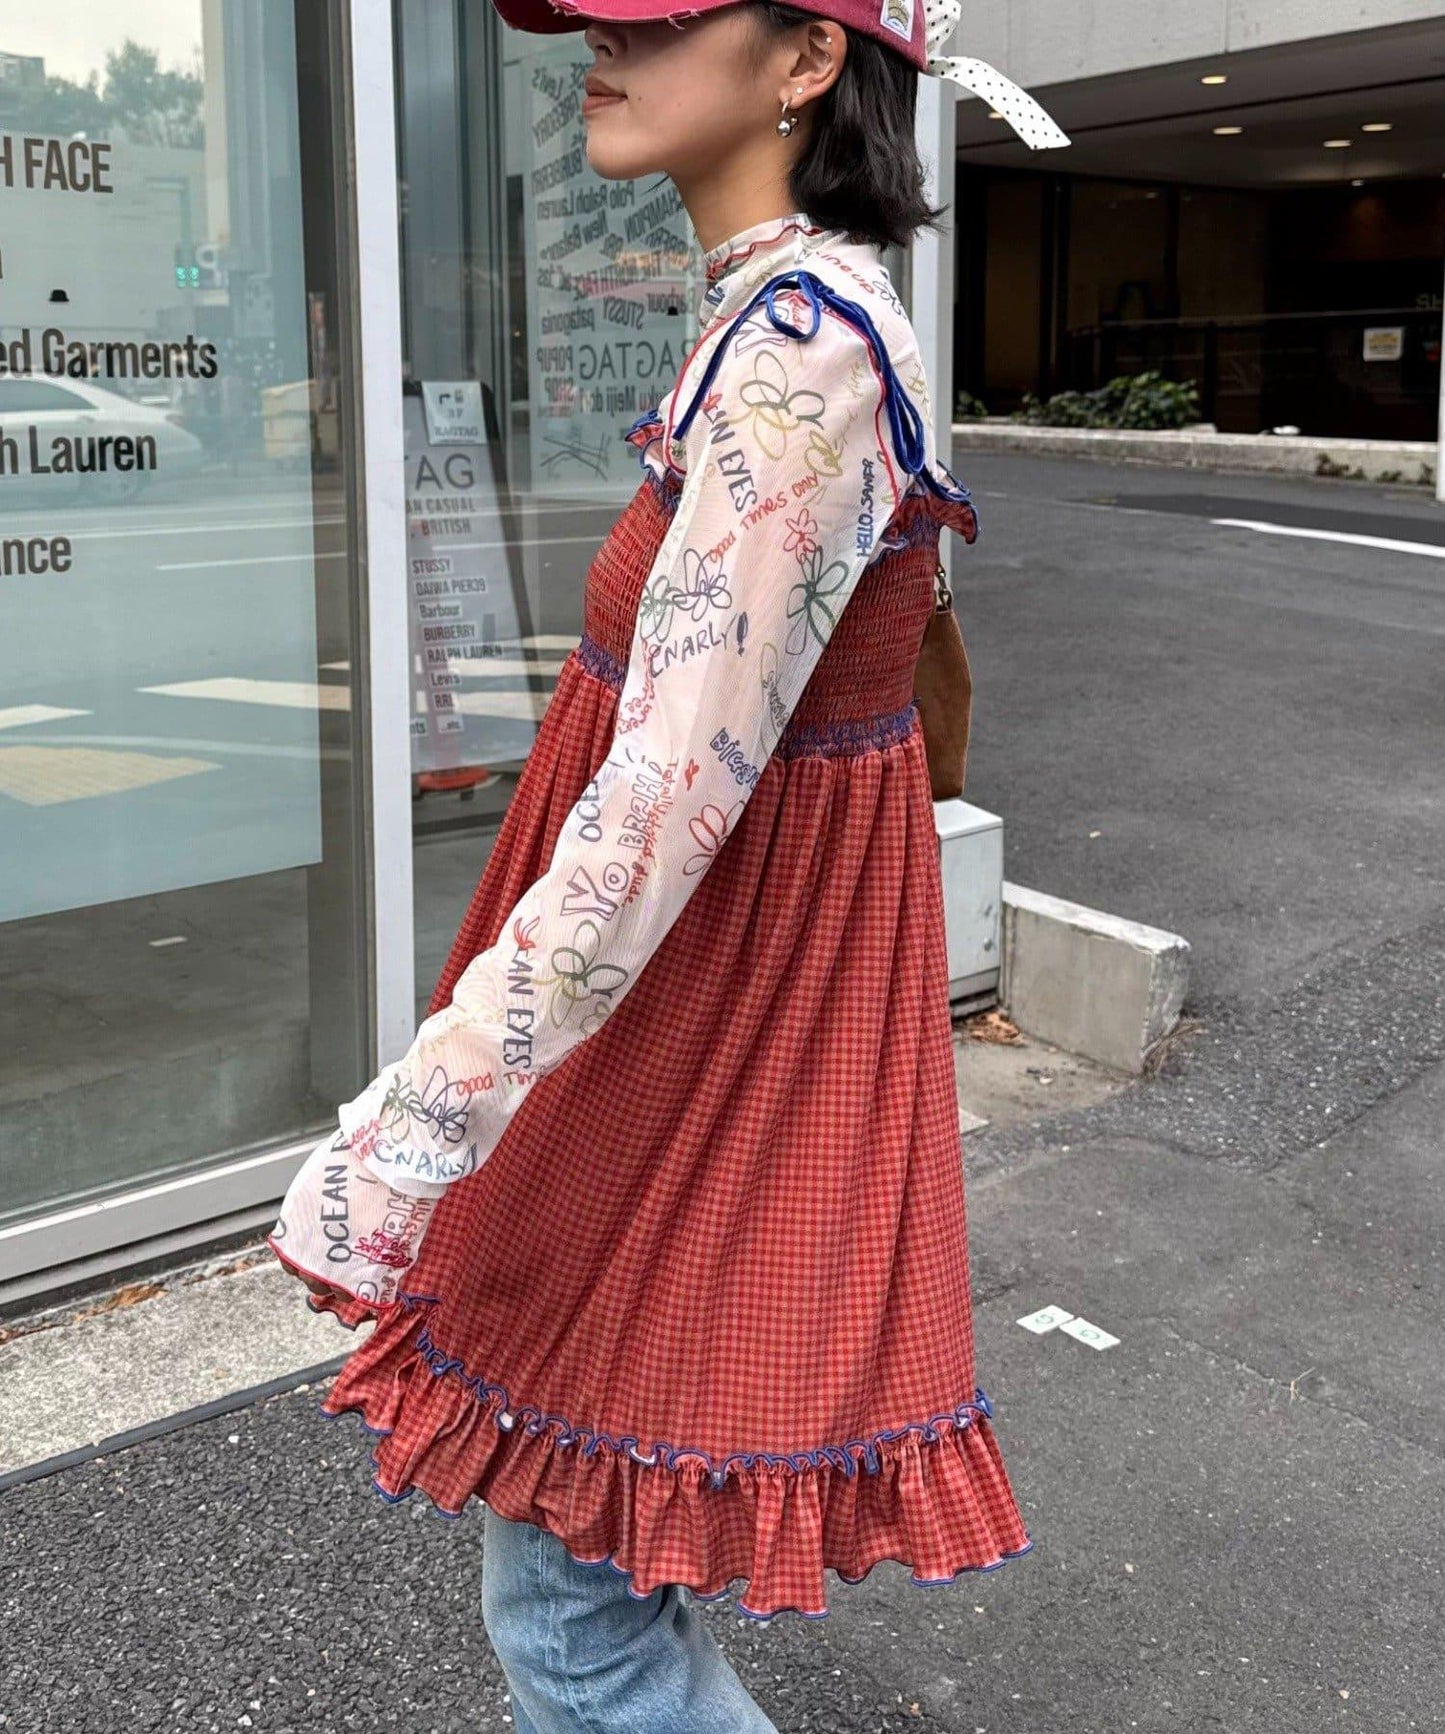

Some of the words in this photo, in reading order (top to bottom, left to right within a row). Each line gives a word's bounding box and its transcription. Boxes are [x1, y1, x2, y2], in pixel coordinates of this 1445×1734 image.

[23, 138, 114, 193] FACE
[42, 327, 218, 379] Garments
[28, 425, 157, 475] Lauren
[403, 453, 476, 491] AG
[717, 448, 758, 513] EYES
[0, 536, 72, 576] nce
[503, 1008, 535, 1069] EYES
[320, 1164, 351, 1263] OCEAN
